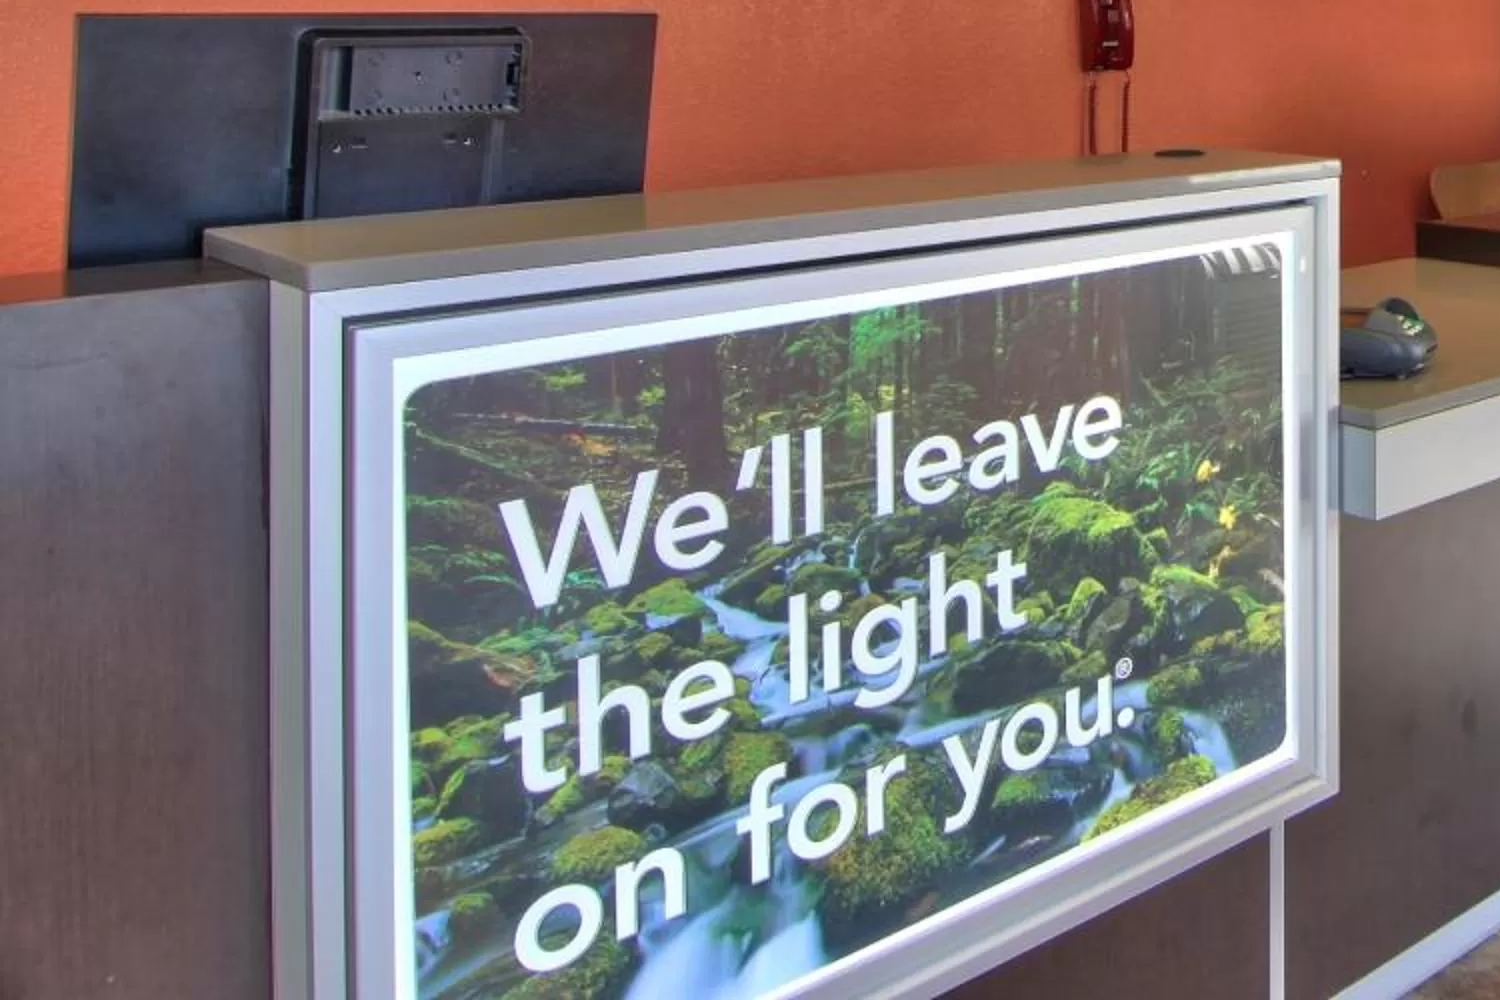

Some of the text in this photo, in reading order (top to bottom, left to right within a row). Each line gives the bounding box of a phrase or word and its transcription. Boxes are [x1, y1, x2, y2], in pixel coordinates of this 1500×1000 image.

[500, 394, 1124, 610] We'll leave
[503, 549, 1028, 795] the light
[512, 844, 689, 974] on
[736, 753, 908, 884] for
